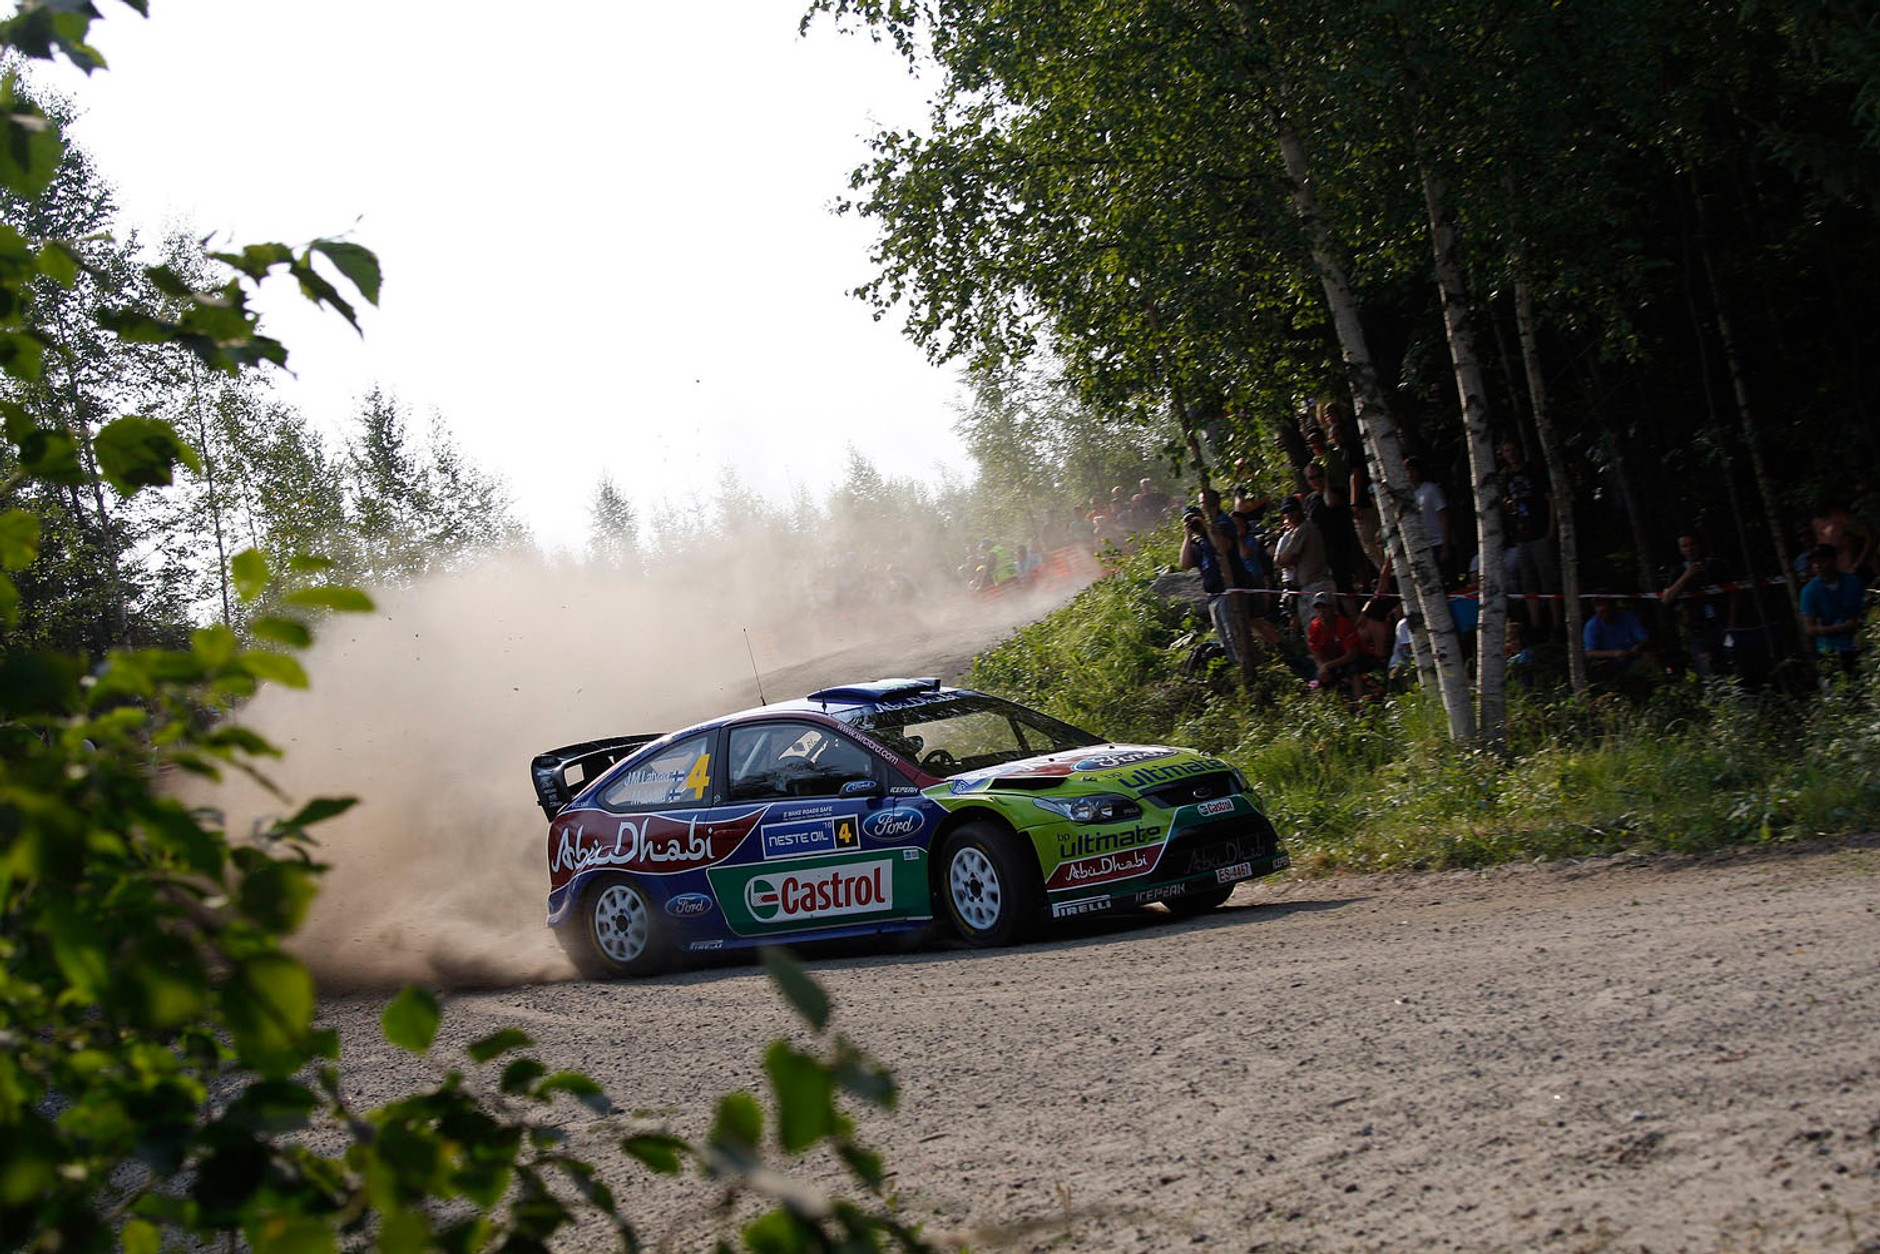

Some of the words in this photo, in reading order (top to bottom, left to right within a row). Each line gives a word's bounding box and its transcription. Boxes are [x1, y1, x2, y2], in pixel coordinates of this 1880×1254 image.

[687, 753, 711, 799] 4
[1118, 758, 1228, 789] ultimate
[889, 786, 919, 794] ICEPEAK
[1207, 800, 1233, 814] Castrol
[838, 822, 852, 844] 4
[873, 811, 915, 837] Ford
[768, 832, 810, 848] NESTE
[810, 830, 830, 843] OIL
[1060, 824, 1161, 859] ultimate
[781, 866, 886, 916] Castrol
[1135, 883, 1186, 902] ICEPEAK
[675, 896, 705, 914] Ford
[1051, 894, 1112, 919] PIRELLI
